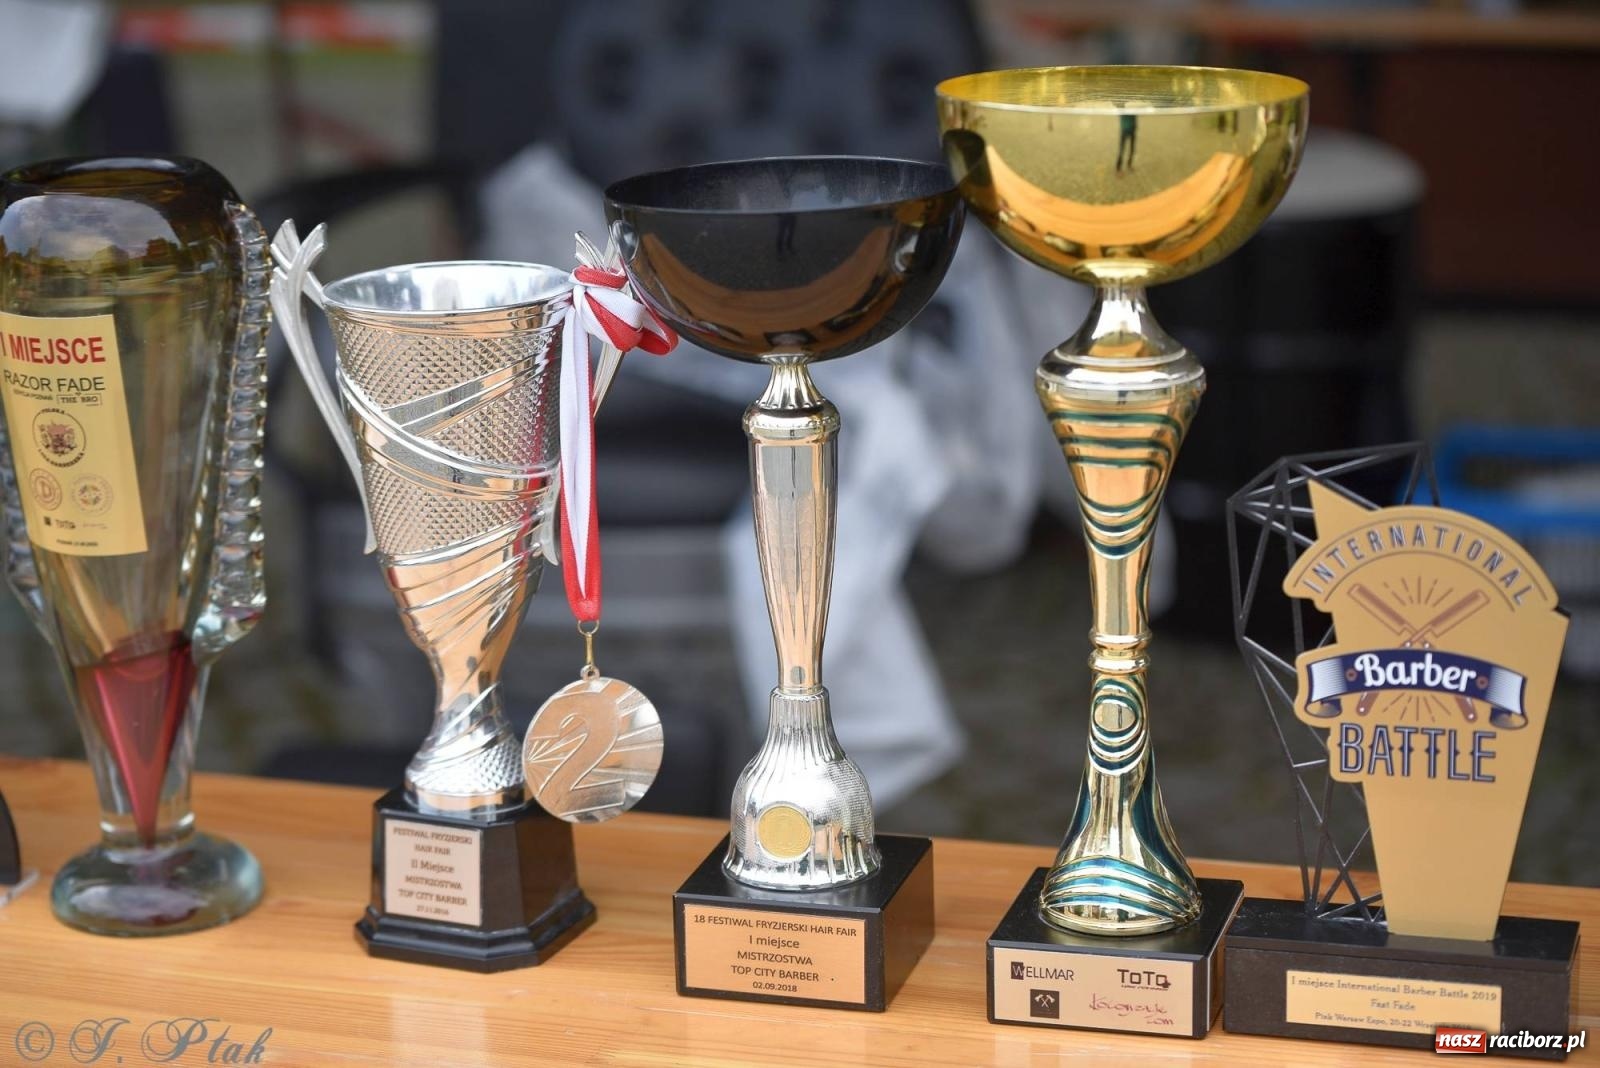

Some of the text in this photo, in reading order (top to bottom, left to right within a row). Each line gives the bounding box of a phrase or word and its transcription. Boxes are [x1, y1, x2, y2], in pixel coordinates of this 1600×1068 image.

[9, 333, 106, 365] MIEJSCE
[4, 370, 106, 392] RAZOR FADE
[60, 395, 98, 404] THE BRO
[1302, 524, 1535, 606] INTERNATIONAL
[1354, 652, 1477, 693] Barber
[1338, 722, 1497, 783] BATTLE
[415, 843, 451, 855] HAIR FAIR
[420, 860, 455, 874] Miejsce
[405, 875, 463, 890] MISTRZOSTWA
[398, 888, 468, 906] TOP CITY BARBER
[694, 914, 857, 937] 18 FESTIWAL FRYZJERSKI HAIR FAIR
[756, 936, 800, 949] miejsce
[737, 950, 813, 967] MISTRZOSTWA
[731, 965, 819, 983] TOP CITY BARBER
[1010, 961, 1075, 982] WELLMAR
[752, 981, 798, 993] 02.09.2018
[1298, 977, 1335, 990] miejsce
[1336, 979, 1401, 994] International
[1403, 984, 1437, 997] Barber
[1439, 987, 1469, 999] Battle
[1471, 991, 1497, 1002] 2019
[1370, 998, 1416, 1012] Fast Fade
